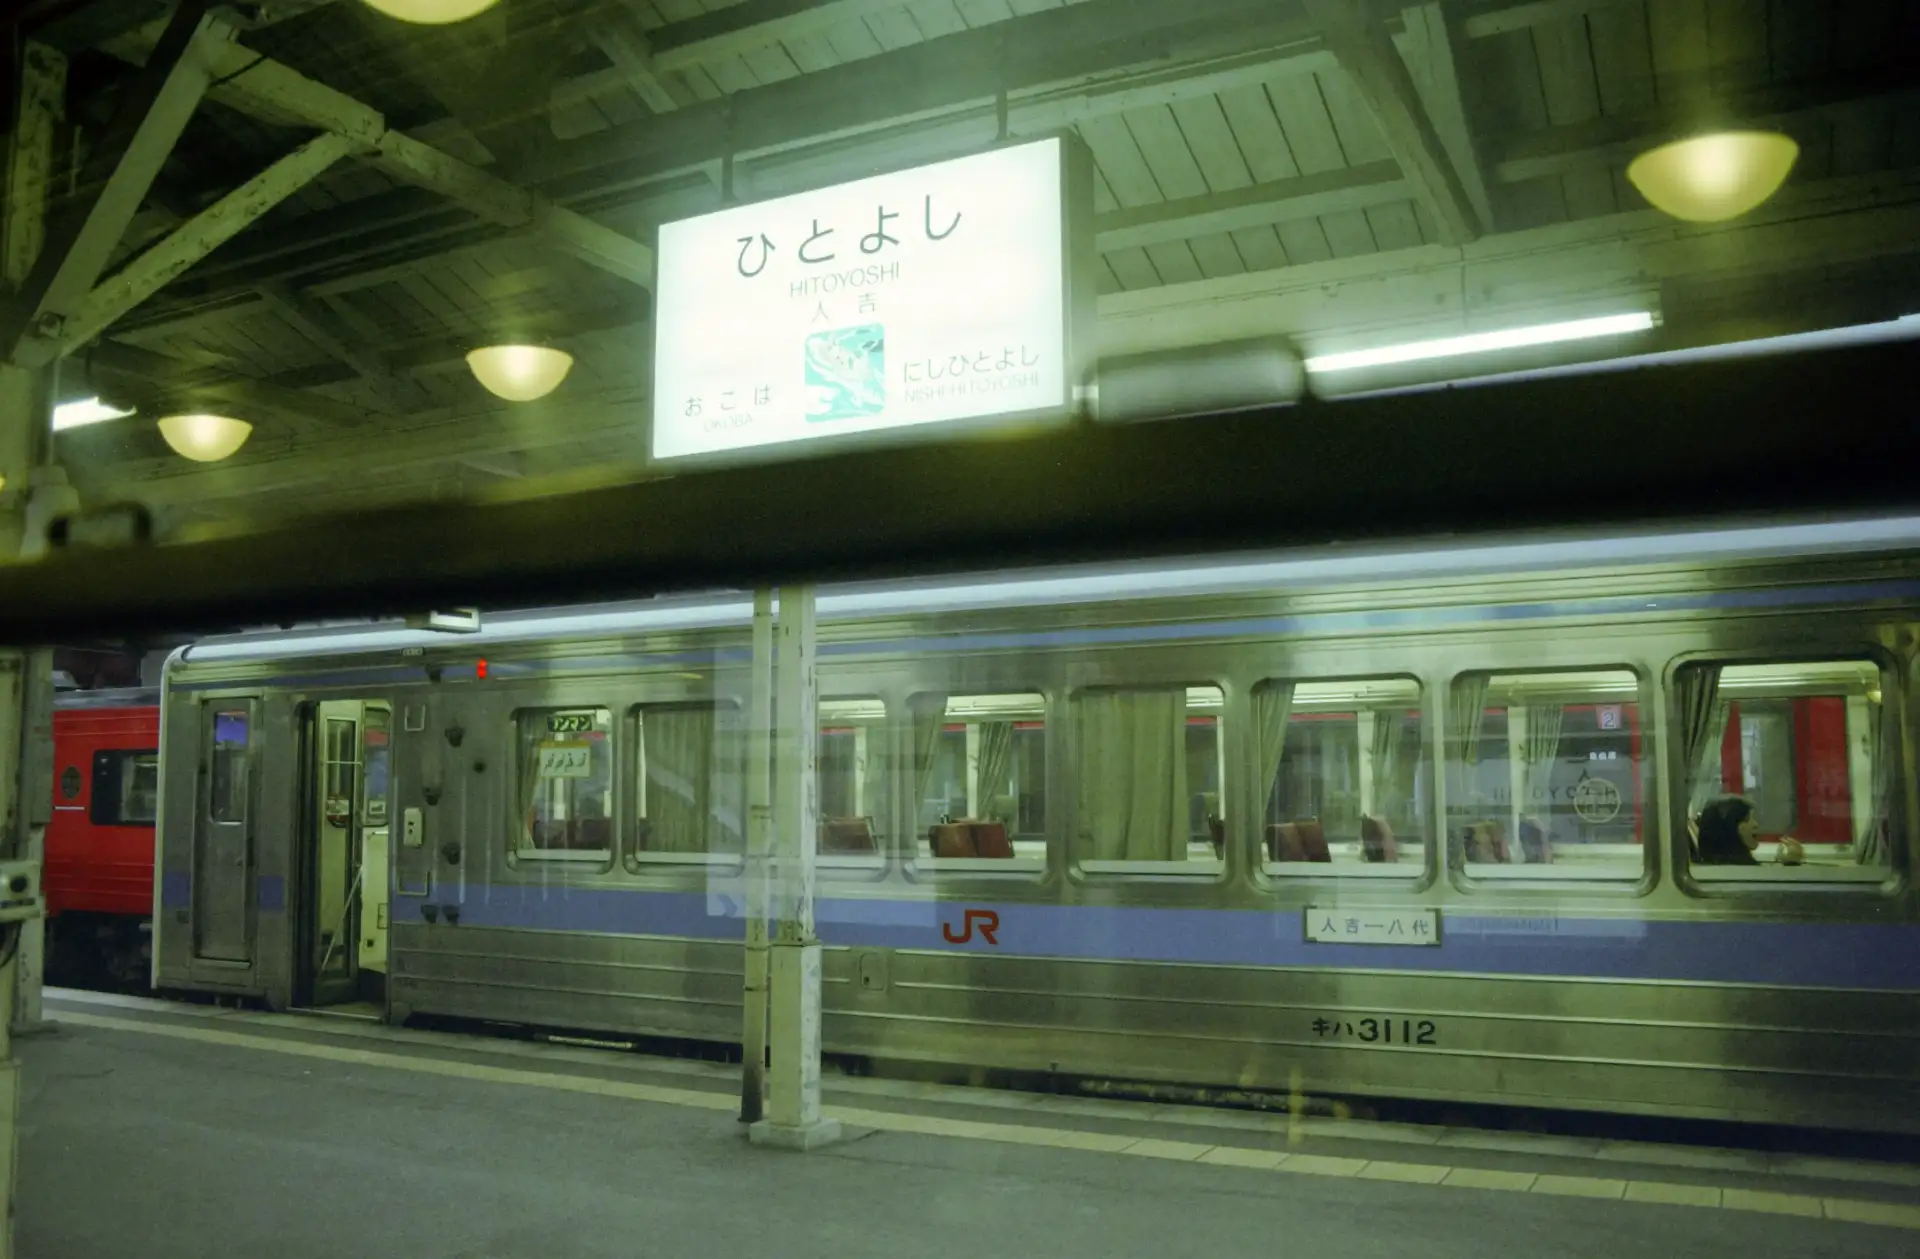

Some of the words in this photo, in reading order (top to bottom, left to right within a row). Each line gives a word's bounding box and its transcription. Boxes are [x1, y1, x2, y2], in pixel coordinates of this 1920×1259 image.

[737, 195, 961, 277] ひとよし
[790, 261, 899, 297] HITOYOSHI
[811, 292, 876, 323] 人吉
[904, 344, 1040, 382] にしひとよし
[684, 384, 772, 416] おこは
[1603, 711, 1614, 728] 2
[943, 908, 999, 944] JR
